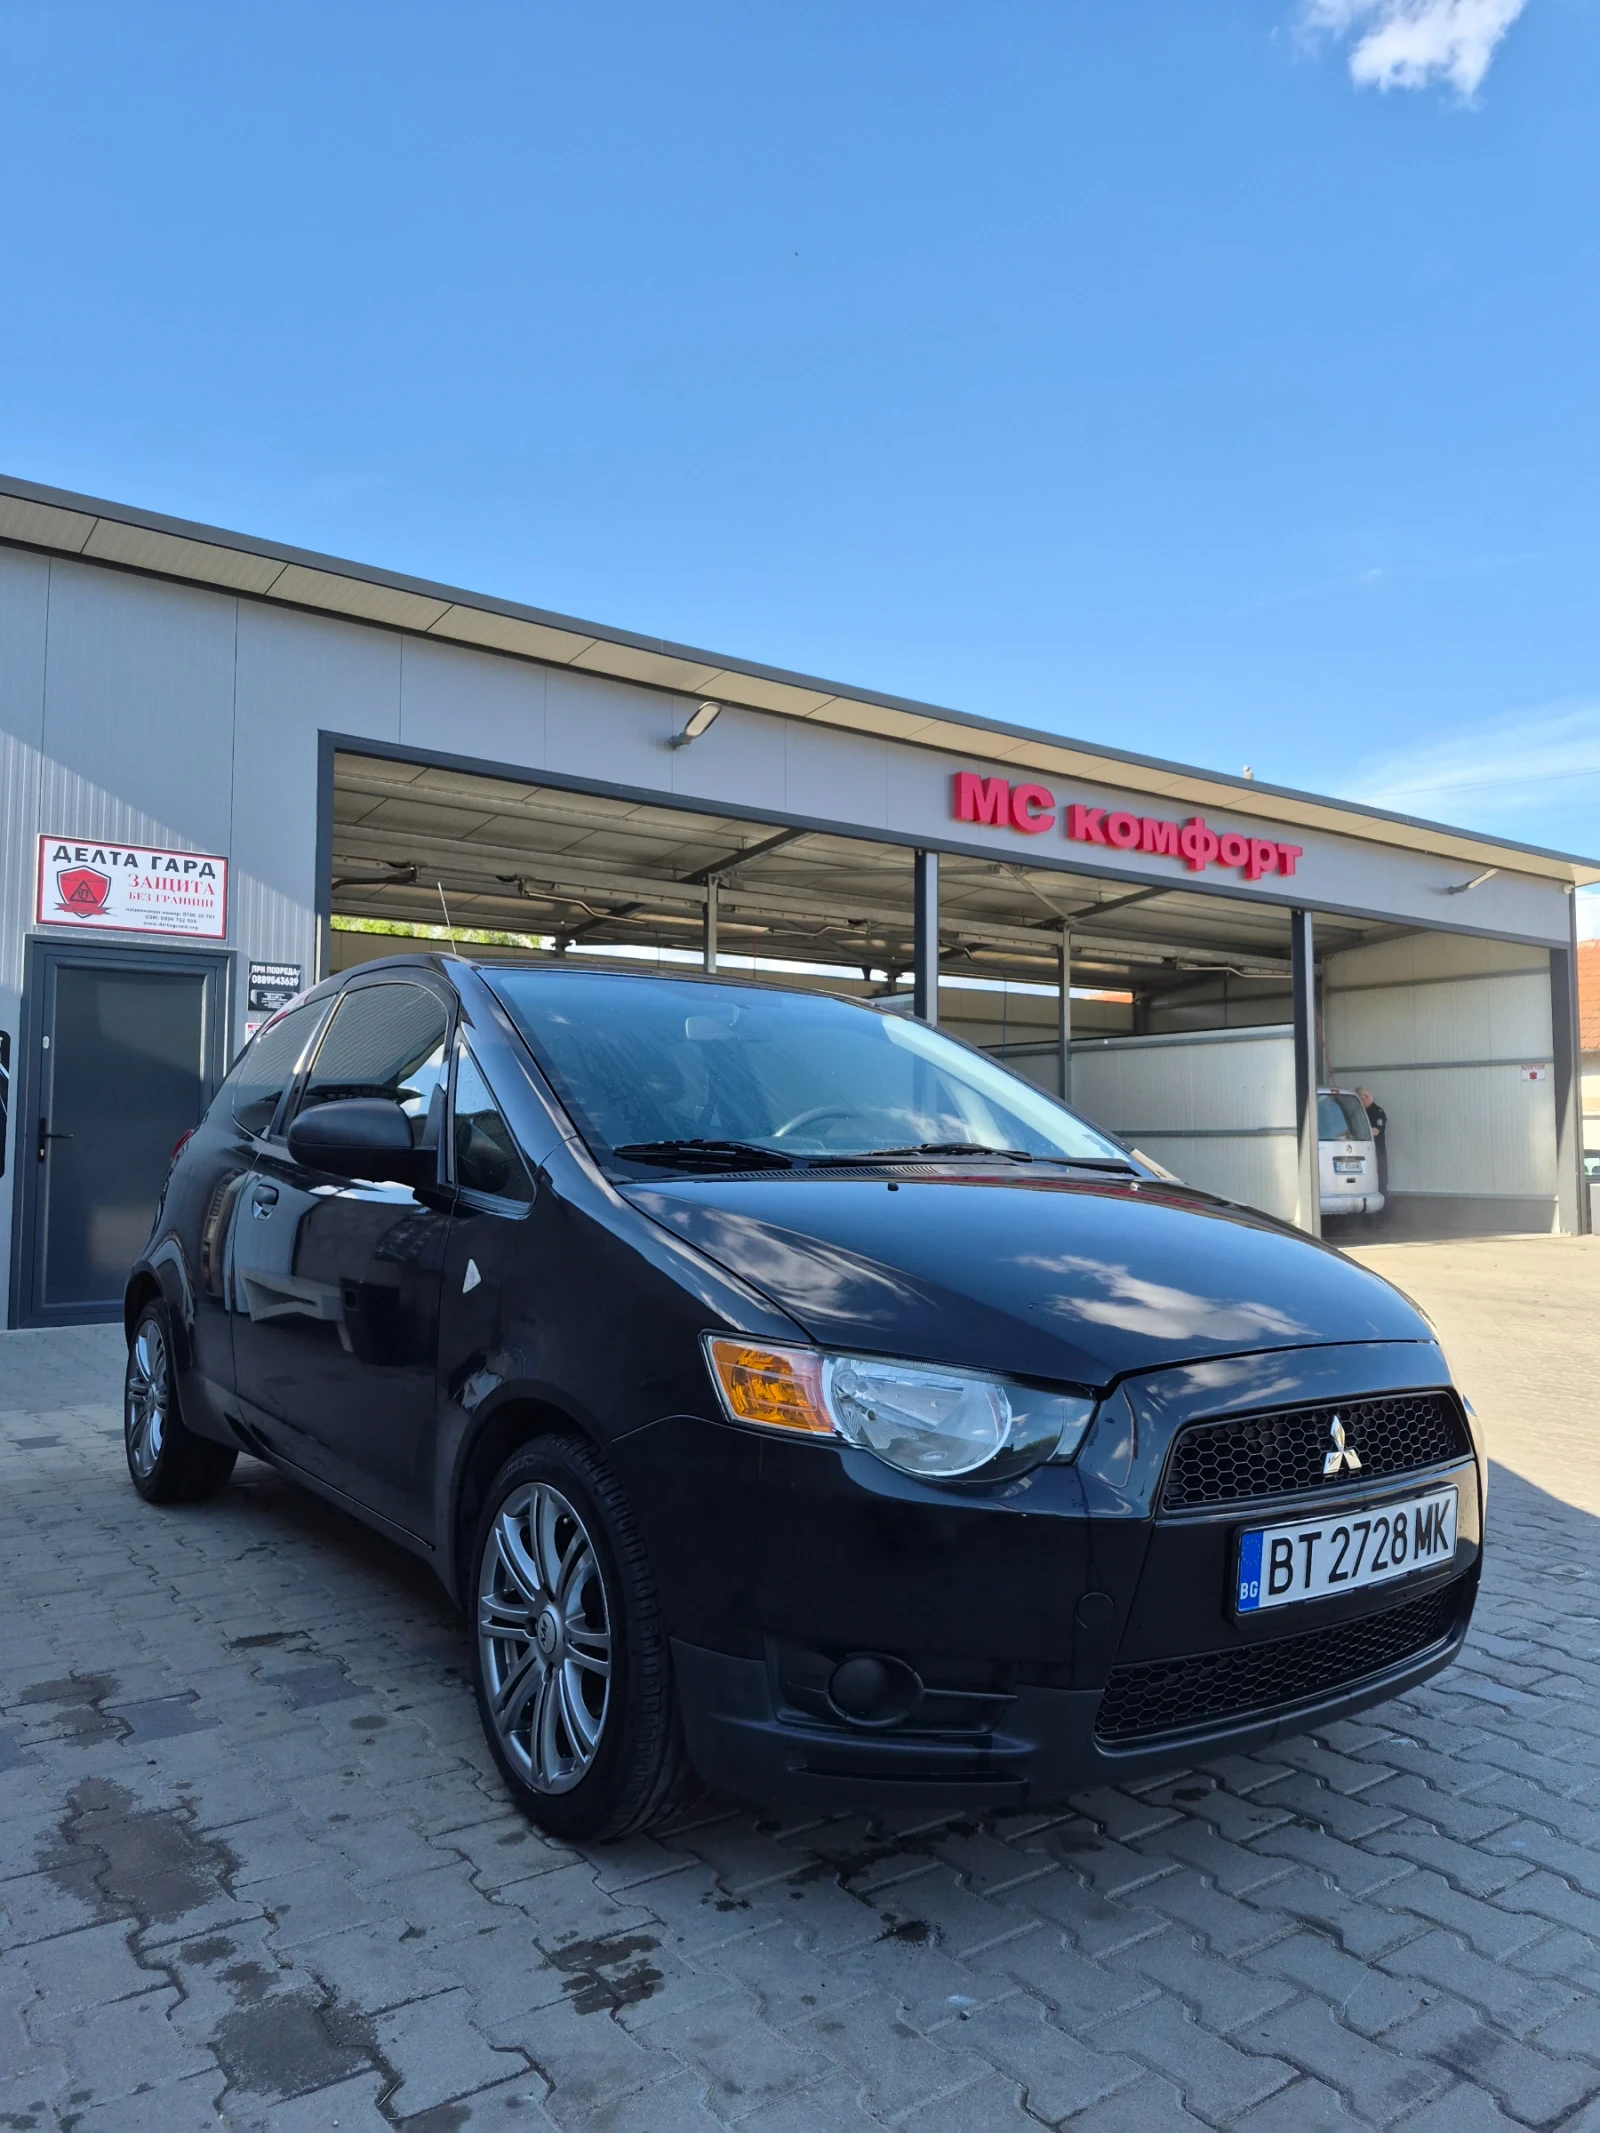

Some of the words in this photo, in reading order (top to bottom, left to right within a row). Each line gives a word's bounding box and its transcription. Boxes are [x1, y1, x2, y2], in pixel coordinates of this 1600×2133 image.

[1066, 803, 1303, 880] комфорт
[52, 845, 138, 868] ДЕЛТА
[151, 856, 216, 879] ГАРД
[128, 873, 215, 895] ЗАЩИТА
[128, 891, 151, 902] БЕЗ
[156, 894, 214, 908] ГРАНИЦИ
[251, 965, 266, 974] ПРИ
[1328, 1512, 1408, 1584] 2728
[1240, 1580, 1259, 1600] BG
